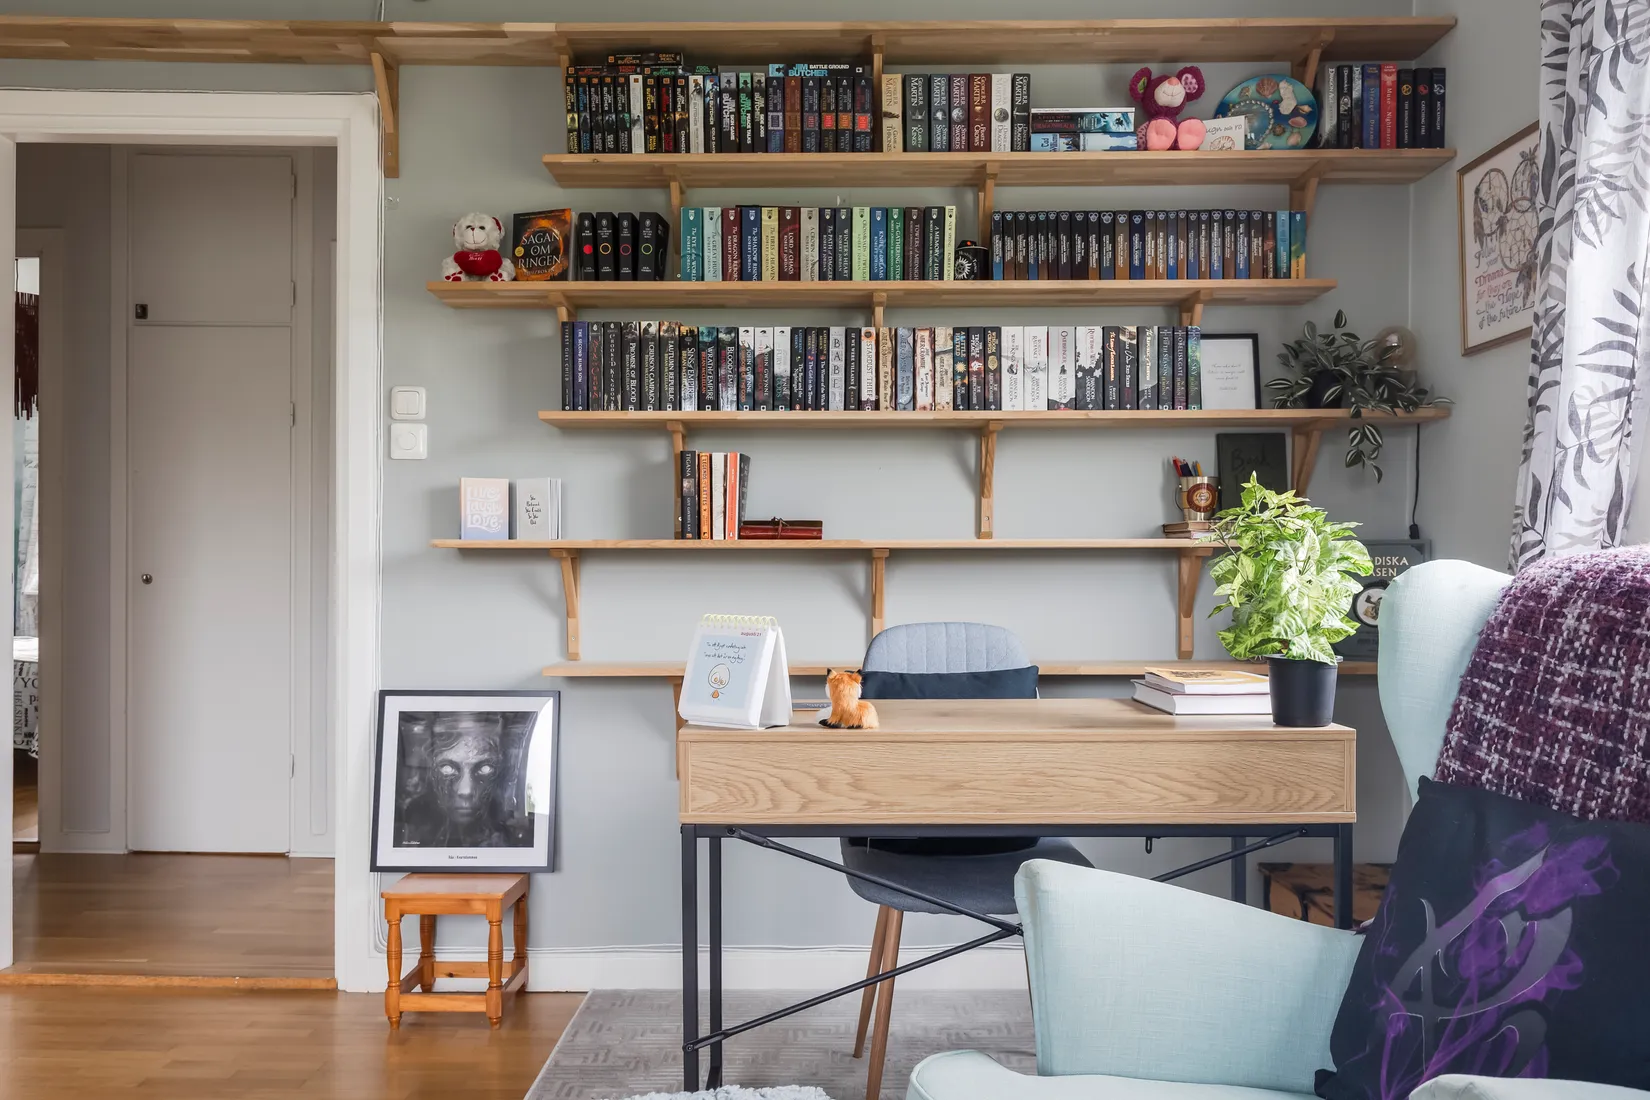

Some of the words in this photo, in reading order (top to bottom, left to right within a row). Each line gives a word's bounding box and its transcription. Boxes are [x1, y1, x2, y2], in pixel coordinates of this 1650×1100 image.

[911, 78, 919, 106] MARTIN
[1015, 76, 1023, 105] MARTIN
[1206, 127, 1222, 135] ugn
[1386, 112, 1394, 146] Nightmares
[522, 232, 560, 244] SAGAN
[530, 245, 550, 256] OM
[518, 255, 561, 268] RINGEN
[1498, 287, 1522, 307] Hope
[1498, 304, 1528, 322] future
[706, 376, 714, 400] EMPIRE
[467, 515, 503, 527] Love
[1371, 557, 1409, 565] DISKA
[14, 691, 22, 735] HELSINKI
